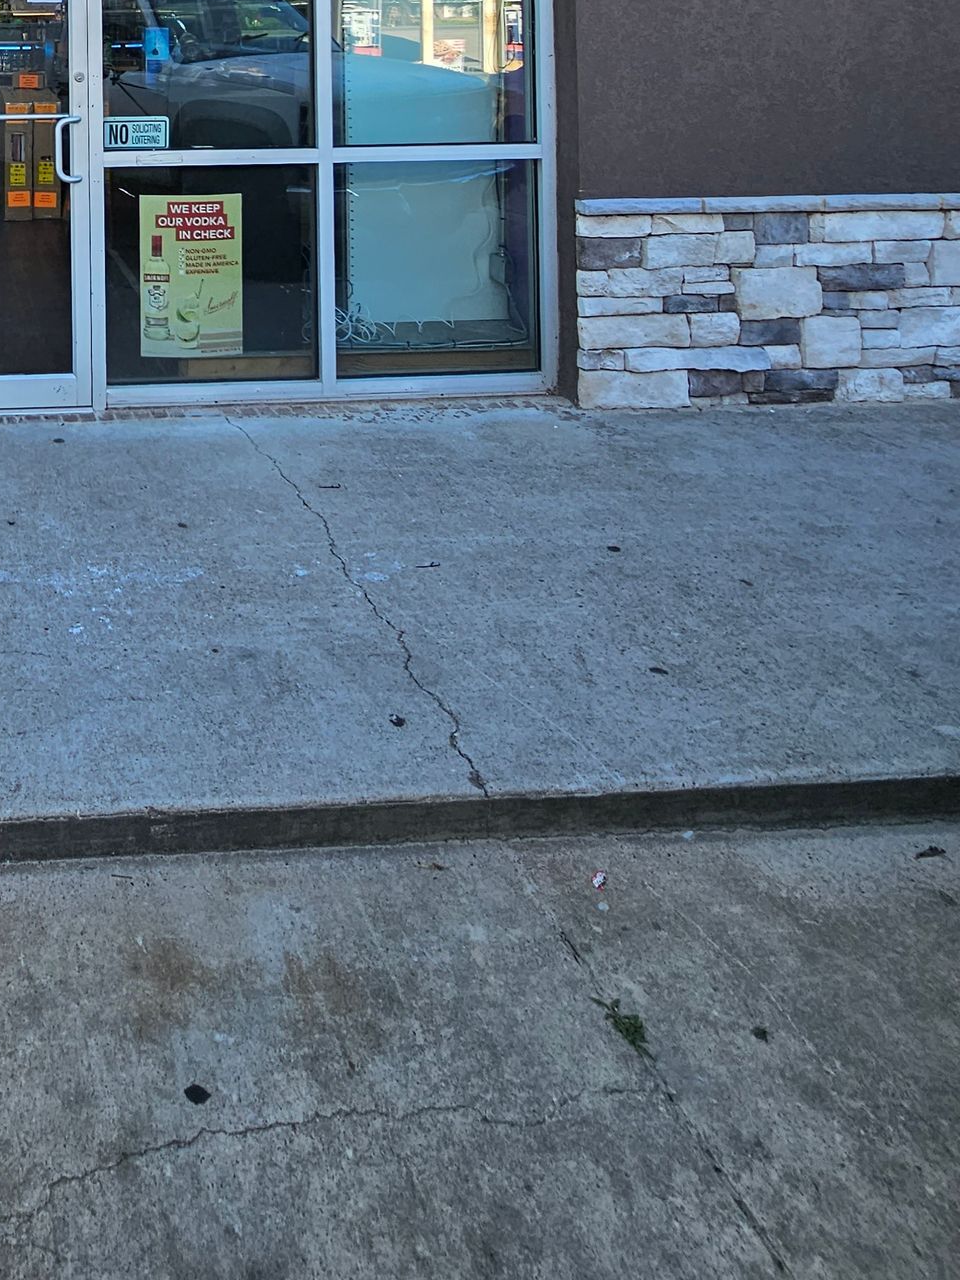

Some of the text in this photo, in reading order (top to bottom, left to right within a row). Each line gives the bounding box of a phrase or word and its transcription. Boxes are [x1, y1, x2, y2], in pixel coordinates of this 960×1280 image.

[131, 123, 162, 134] SOLICITING
[109, 124, 129, 145] NO
[131, 134, 160, 145] LOITERING
[169, 203, 220, 214] WE KEEP
[158, 216, 225, 227] OUR VODKA
[179, 228, 232, 240] IN CHECK
